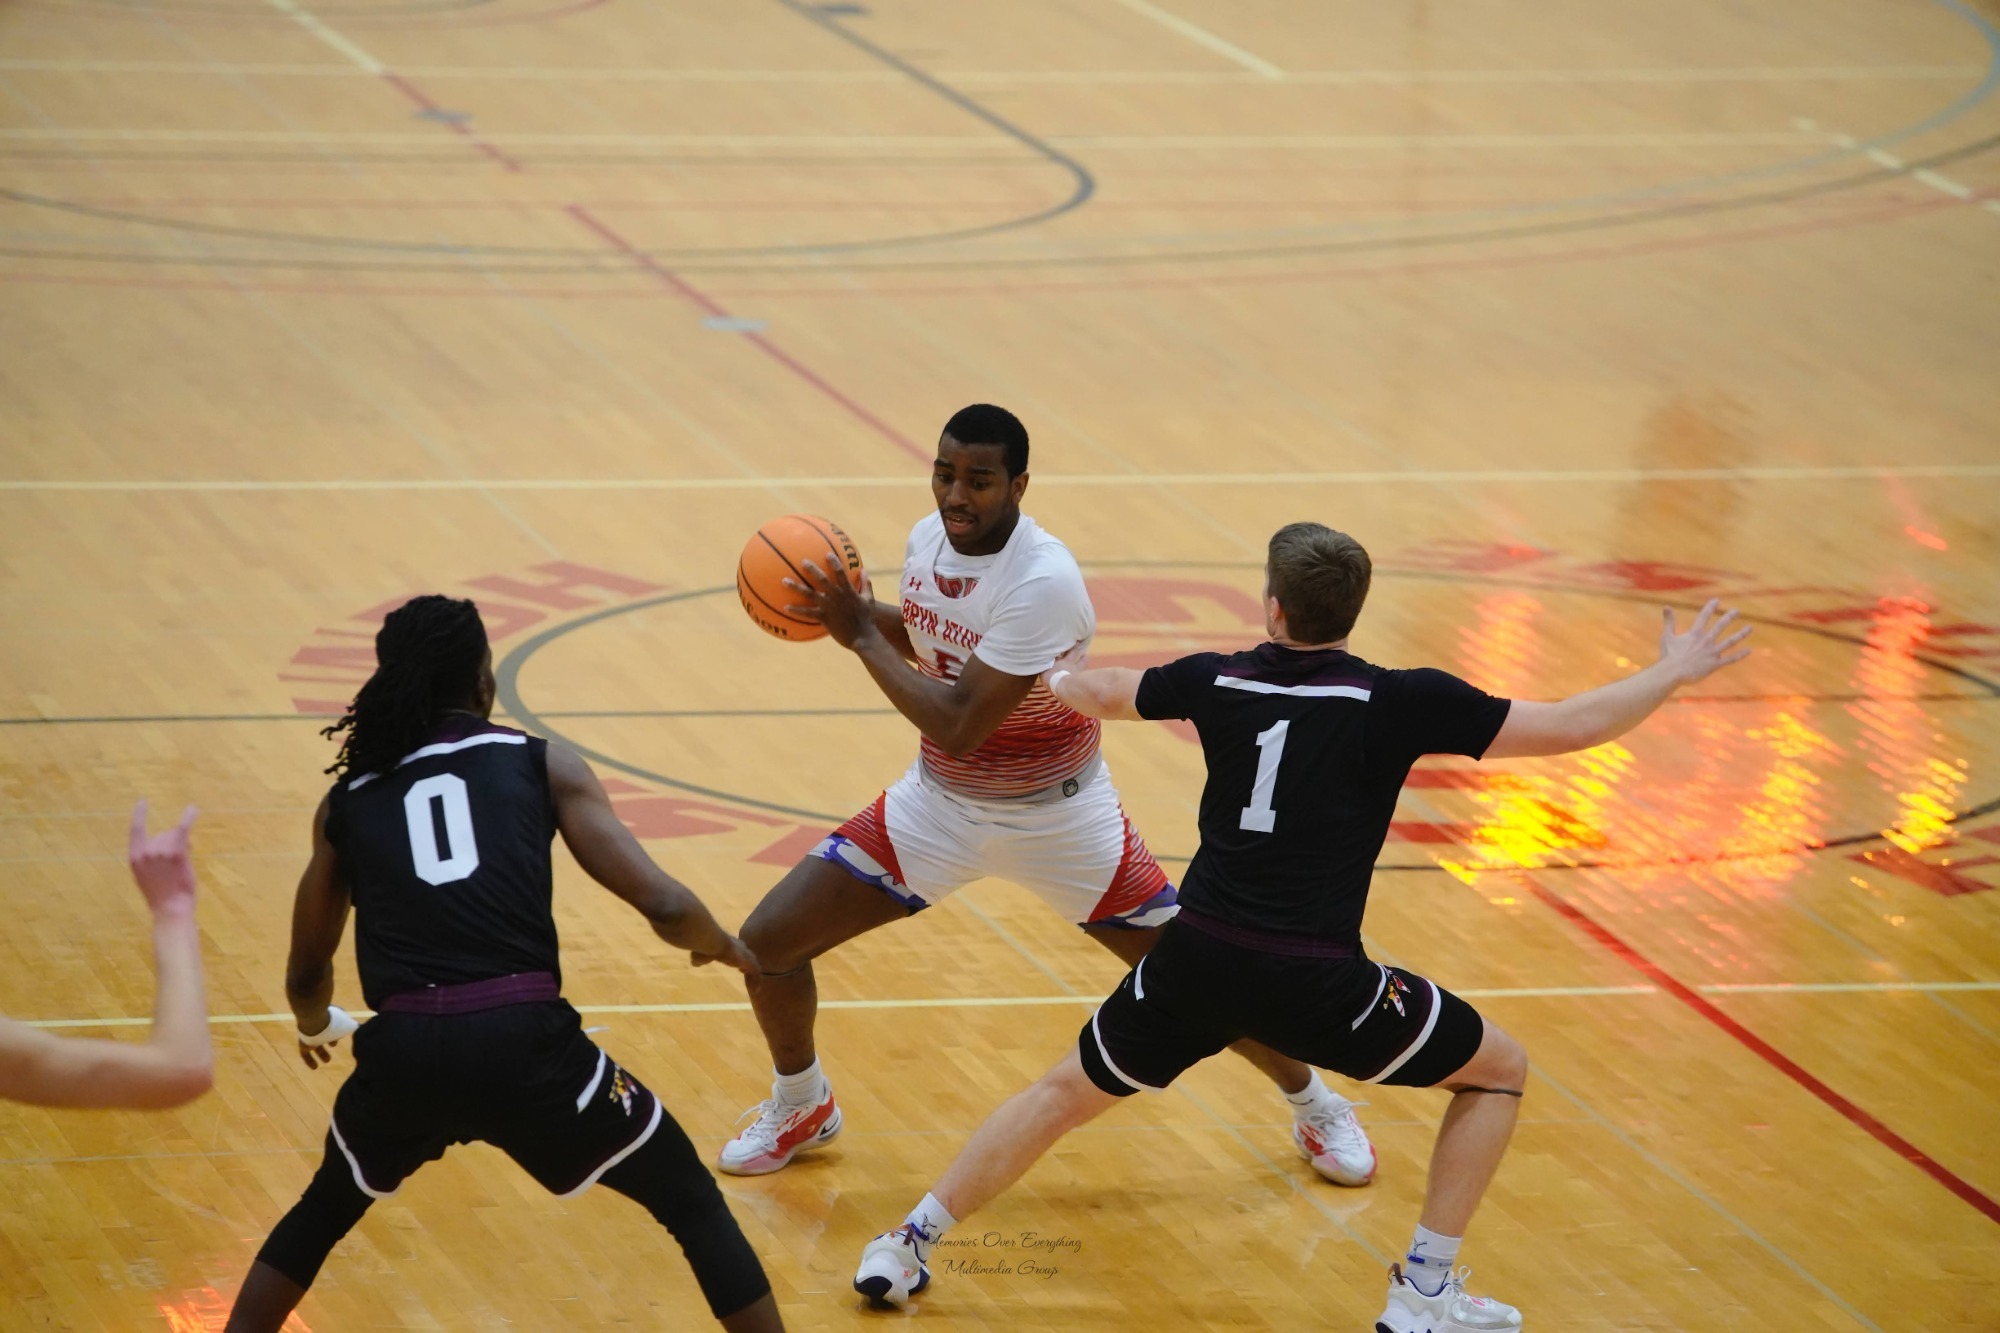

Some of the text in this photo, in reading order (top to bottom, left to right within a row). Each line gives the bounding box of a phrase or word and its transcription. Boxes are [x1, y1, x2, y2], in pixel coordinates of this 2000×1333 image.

[903, 598, 984, 651] BRYN ATHY
[403, 772, 480, 887] 0
[1239, 719, 1290, 833] 1
